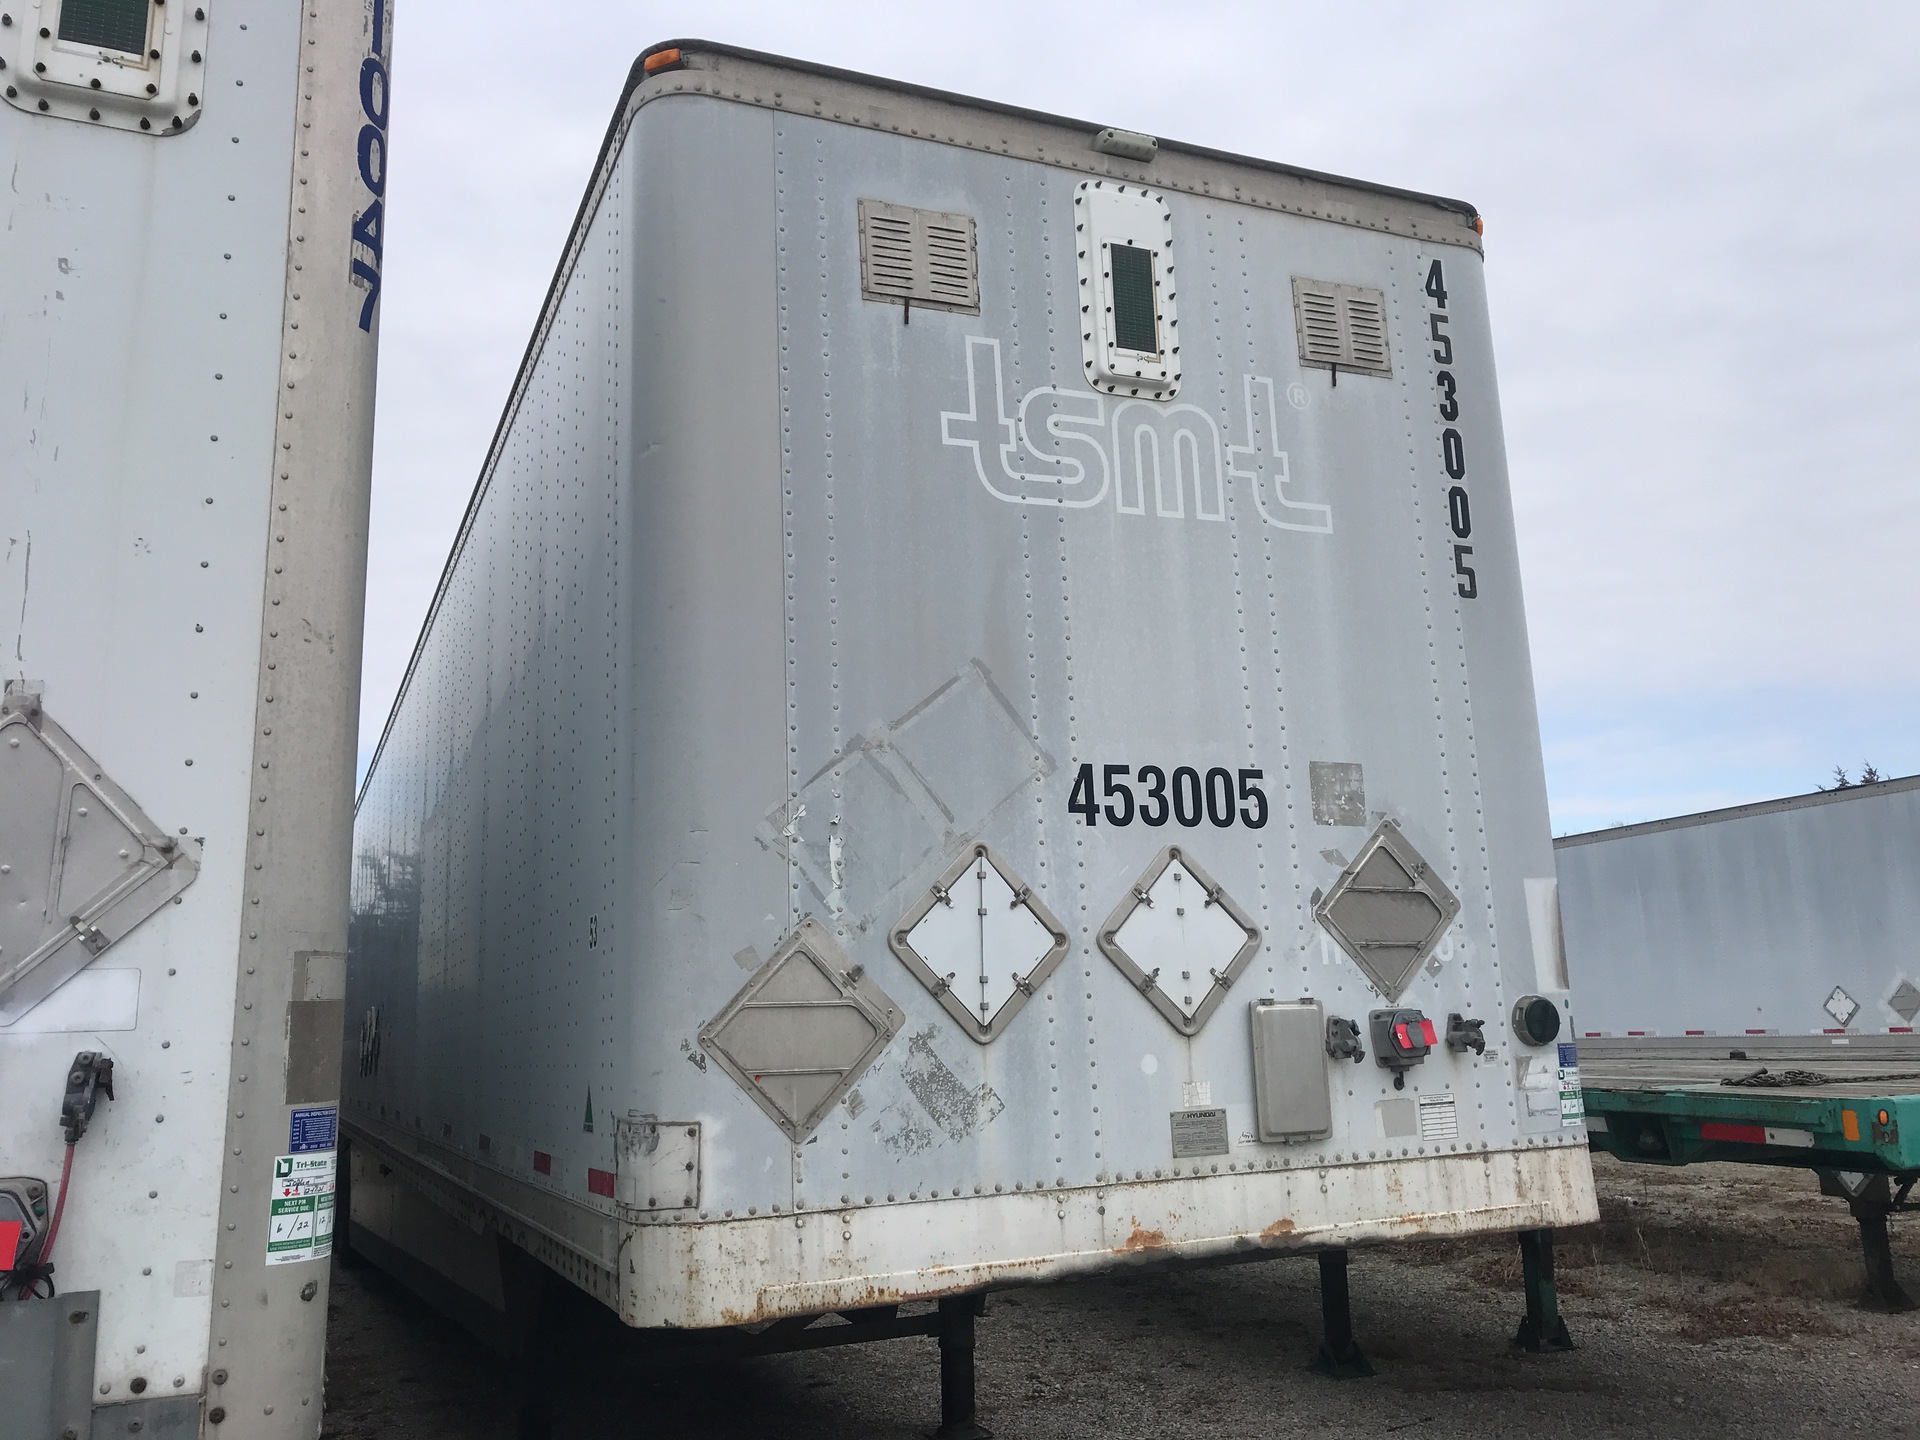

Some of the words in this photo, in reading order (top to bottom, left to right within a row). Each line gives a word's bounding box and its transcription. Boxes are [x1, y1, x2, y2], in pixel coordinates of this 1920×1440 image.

[941, 335, 1333, 534] tsmt
[1425, 259, 1478, 599] 453005
[1068, 763, 1268, 829] 453005
[1187, 1111, 1216, 1119] HYUNDAI
[296, 1160, 327, 1168] Tri-State
[278, 1206, 299, 1214] SERVICE
